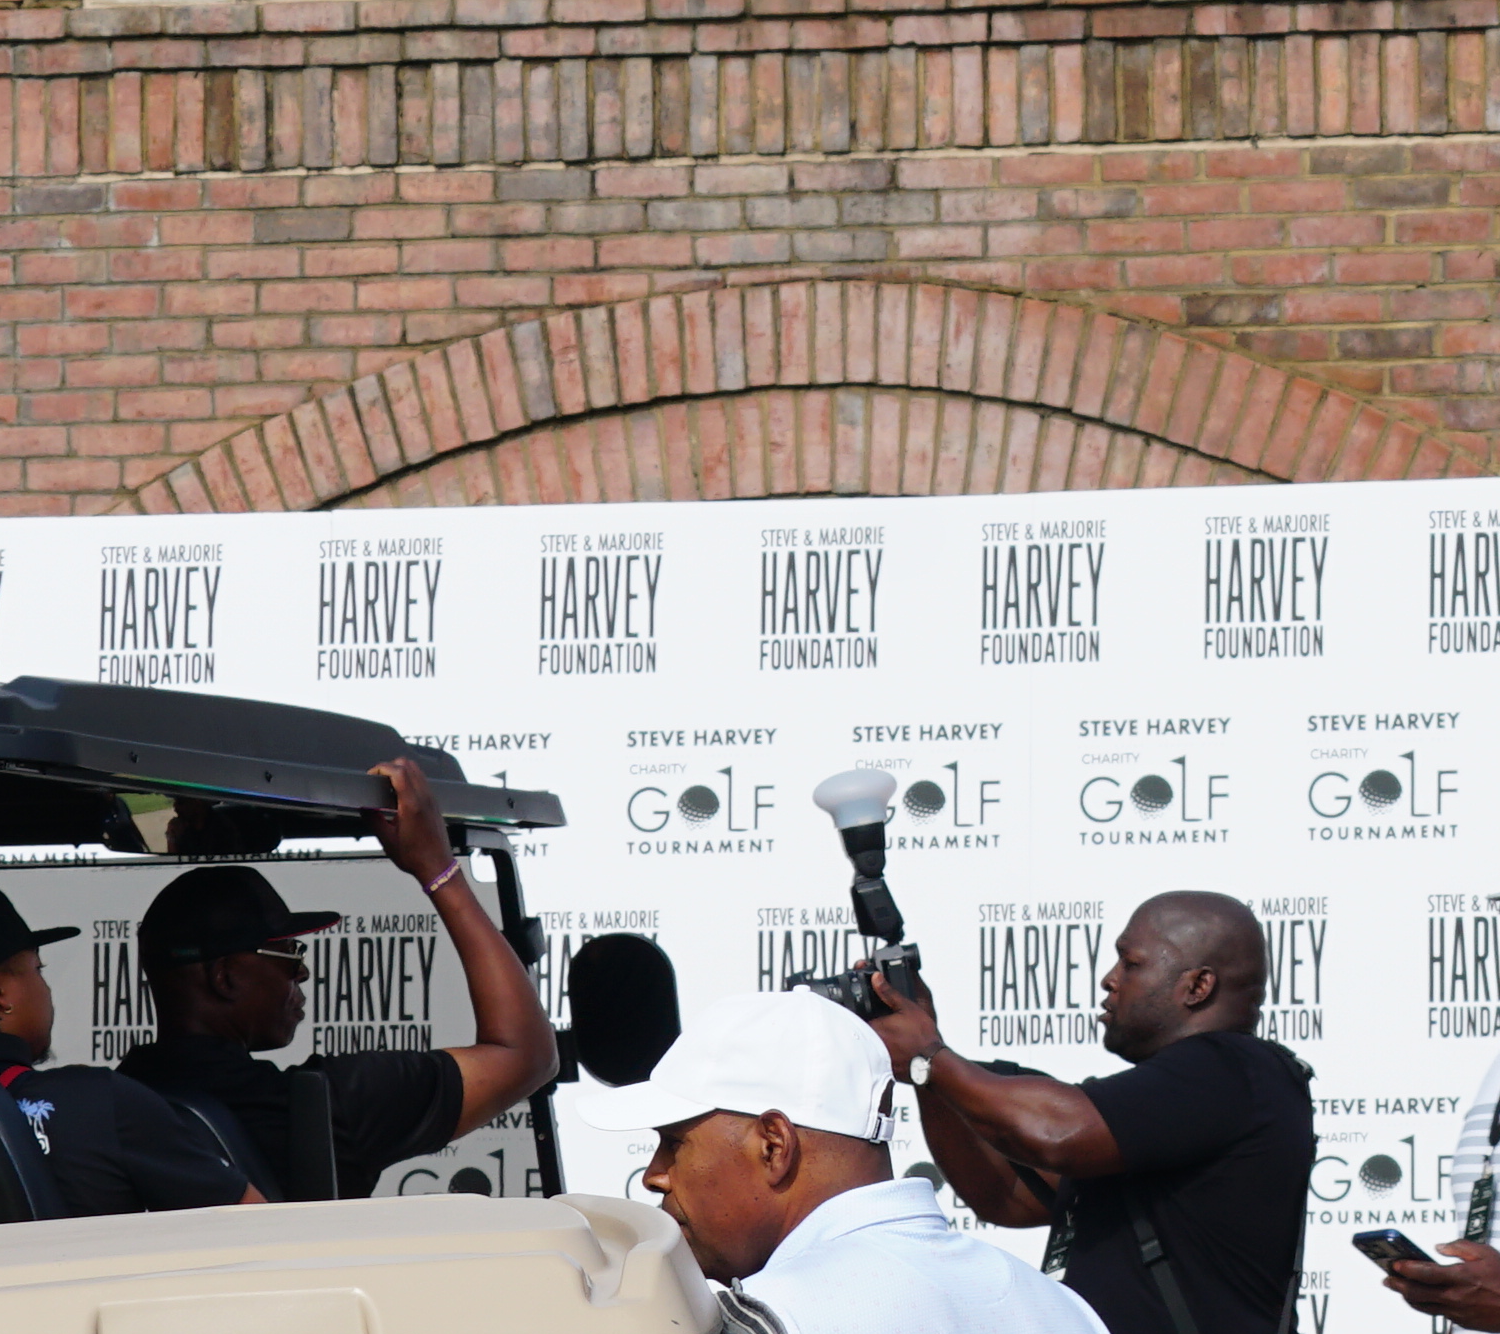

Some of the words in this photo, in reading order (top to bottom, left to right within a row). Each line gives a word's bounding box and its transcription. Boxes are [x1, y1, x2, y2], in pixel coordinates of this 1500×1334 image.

[1206, 517, 1241, 534] STEVE
[1249, 518, 1256, 533] &
[1264, 514, 1328, 532] MARJORIE
[762, 529, 796, 547] STEVE
[804, 531, 812, 545] &
[820, 527, 883, 544] MARJORIE
[320, 540, 356, 558] STEVE
[364, 541, 371, 556] &
[379, 538, 442, 555] MARJORIE
[1206, 537, 1327, 623] HARVEY
[761, 549, 882, 635] HARVEY
[319, 560, 441, 645] HARVEY
[1205, 626, 1323, 659] FOUNDATION
[318, 647, 435, 680] FOUNDATION
[760, 637, 877, 670] FOUNDATION
[1080, 720, 1137, 736] STEVE
[1147, 718, 1230, 735] HARVEY
[1308, 715, 1365, 731] STEVE
[1376, 713, 1459, 730] HARVEY
[628, 731, 684, 747] STEVE
[694, 729, 776, 745] HARVEY
[1082, 752, 1139, 764] CHARITY
[1310, 748, 1368, 759] CHARITY
[630, 763, 686, 775] CHARITY
[1080, 830, 1228, 845] TOURNAMENT
[1309, 825, 1457, 840] TOURNAMENT
[628, 839, 773, 854] TOURNAMENT
[979, 904, 1015, 922] STEVE
[1022, 905, 1030, 920] &
[1038, 901, 1103, 919] MARJORIE
[980, 924, 1102, 1010] HARVEY
[980, 1013, 1098, 1046] FOUNDATION
